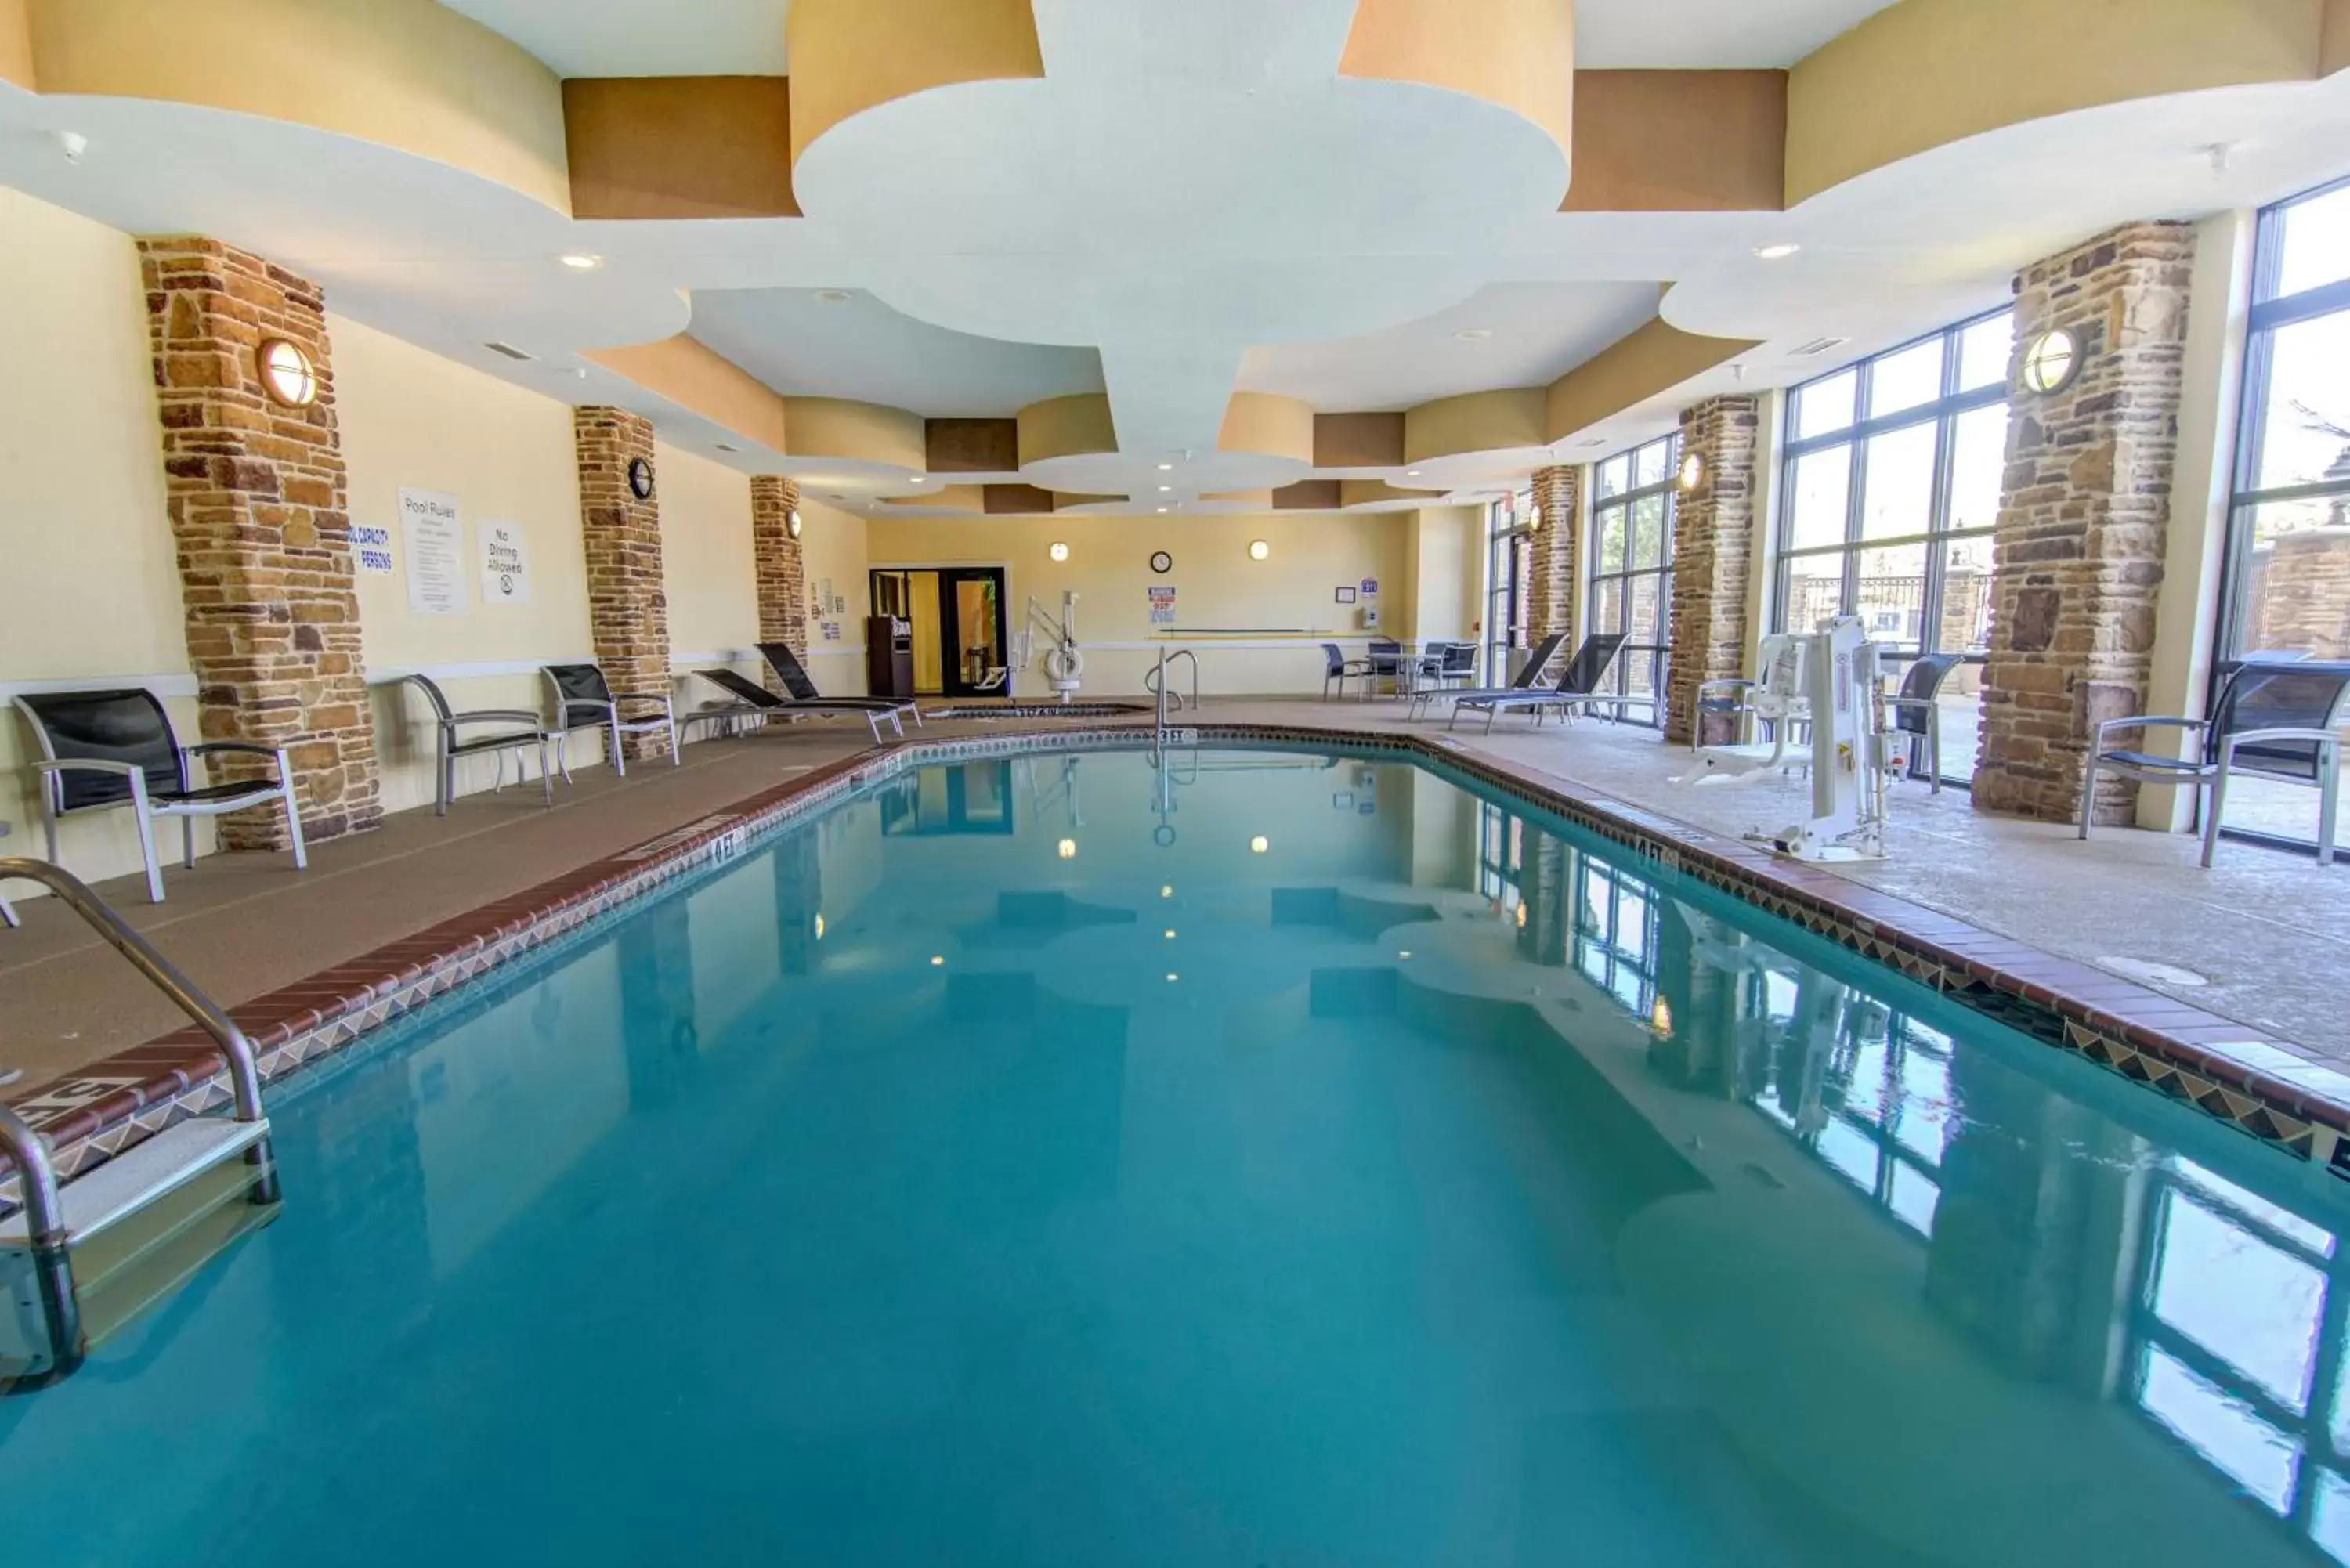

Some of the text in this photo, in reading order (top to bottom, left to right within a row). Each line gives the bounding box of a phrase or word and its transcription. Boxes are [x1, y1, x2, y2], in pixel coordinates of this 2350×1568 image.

[405, 497, 455, 520] Pool Rules
[496, 528, 508, 541] No
